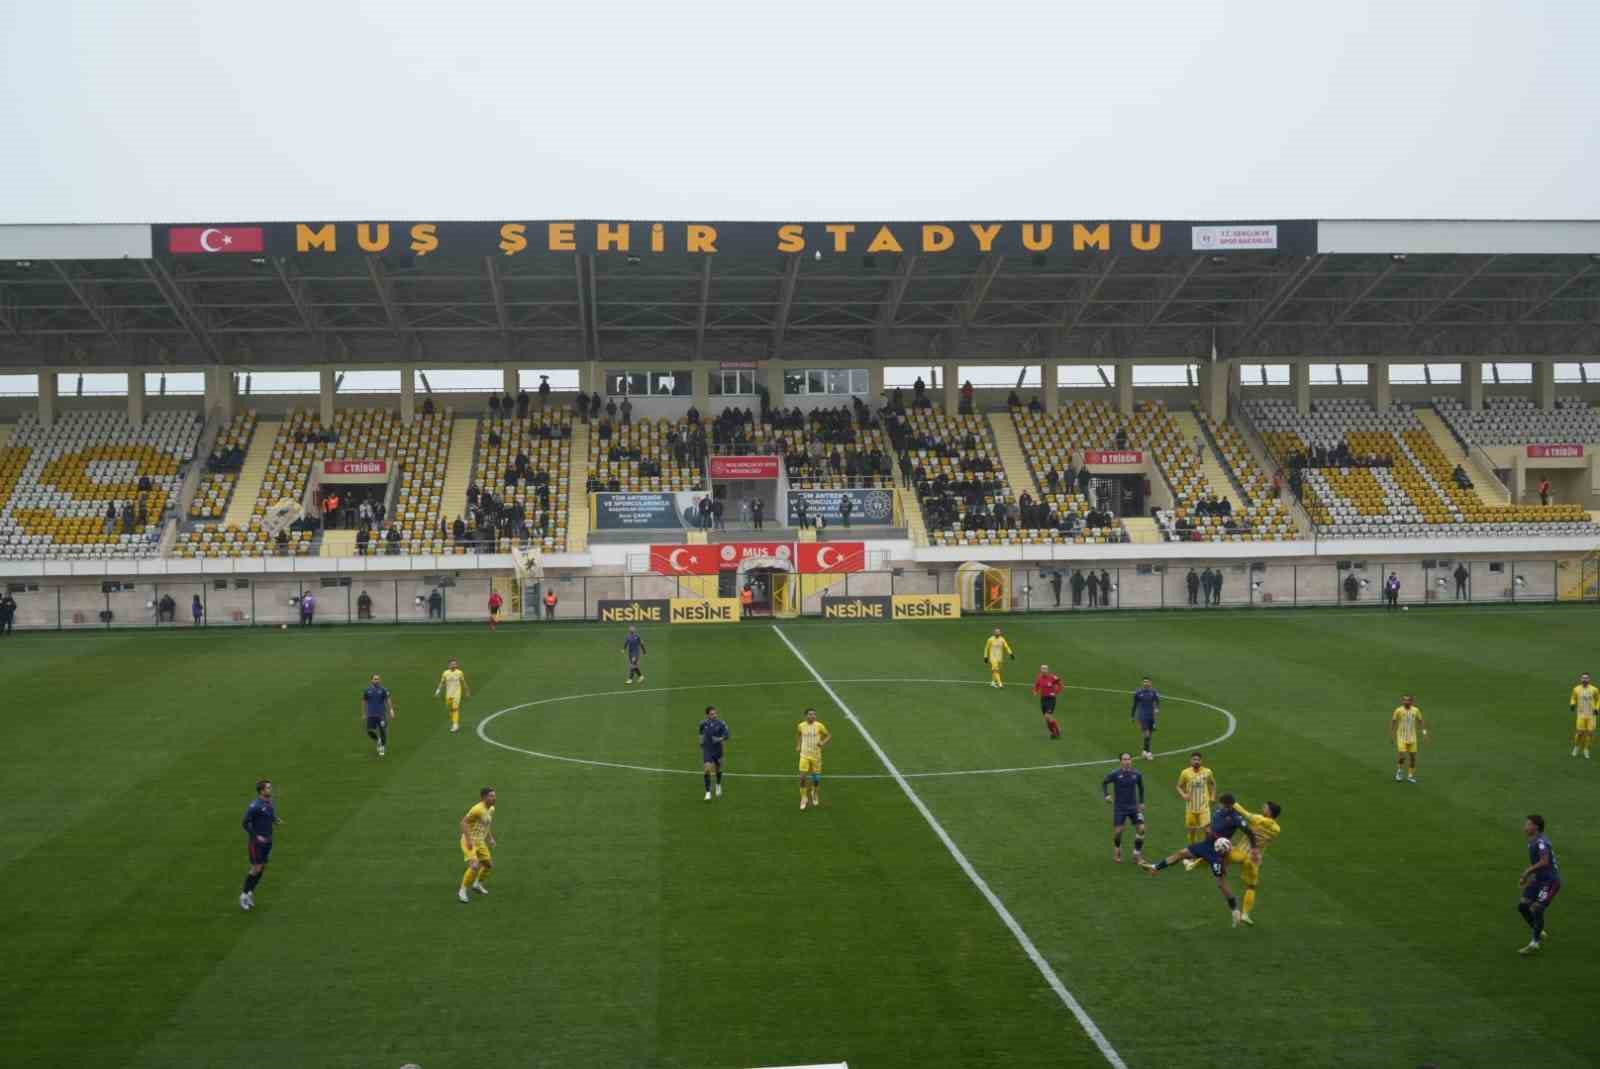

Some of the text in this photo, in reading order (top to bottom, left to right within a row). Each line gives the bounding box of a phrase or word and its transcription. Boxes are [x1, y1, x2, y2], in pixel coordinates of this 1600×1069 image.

[297, 223, 1162, 257] MUŞ ŞEHİR STADYUMU
